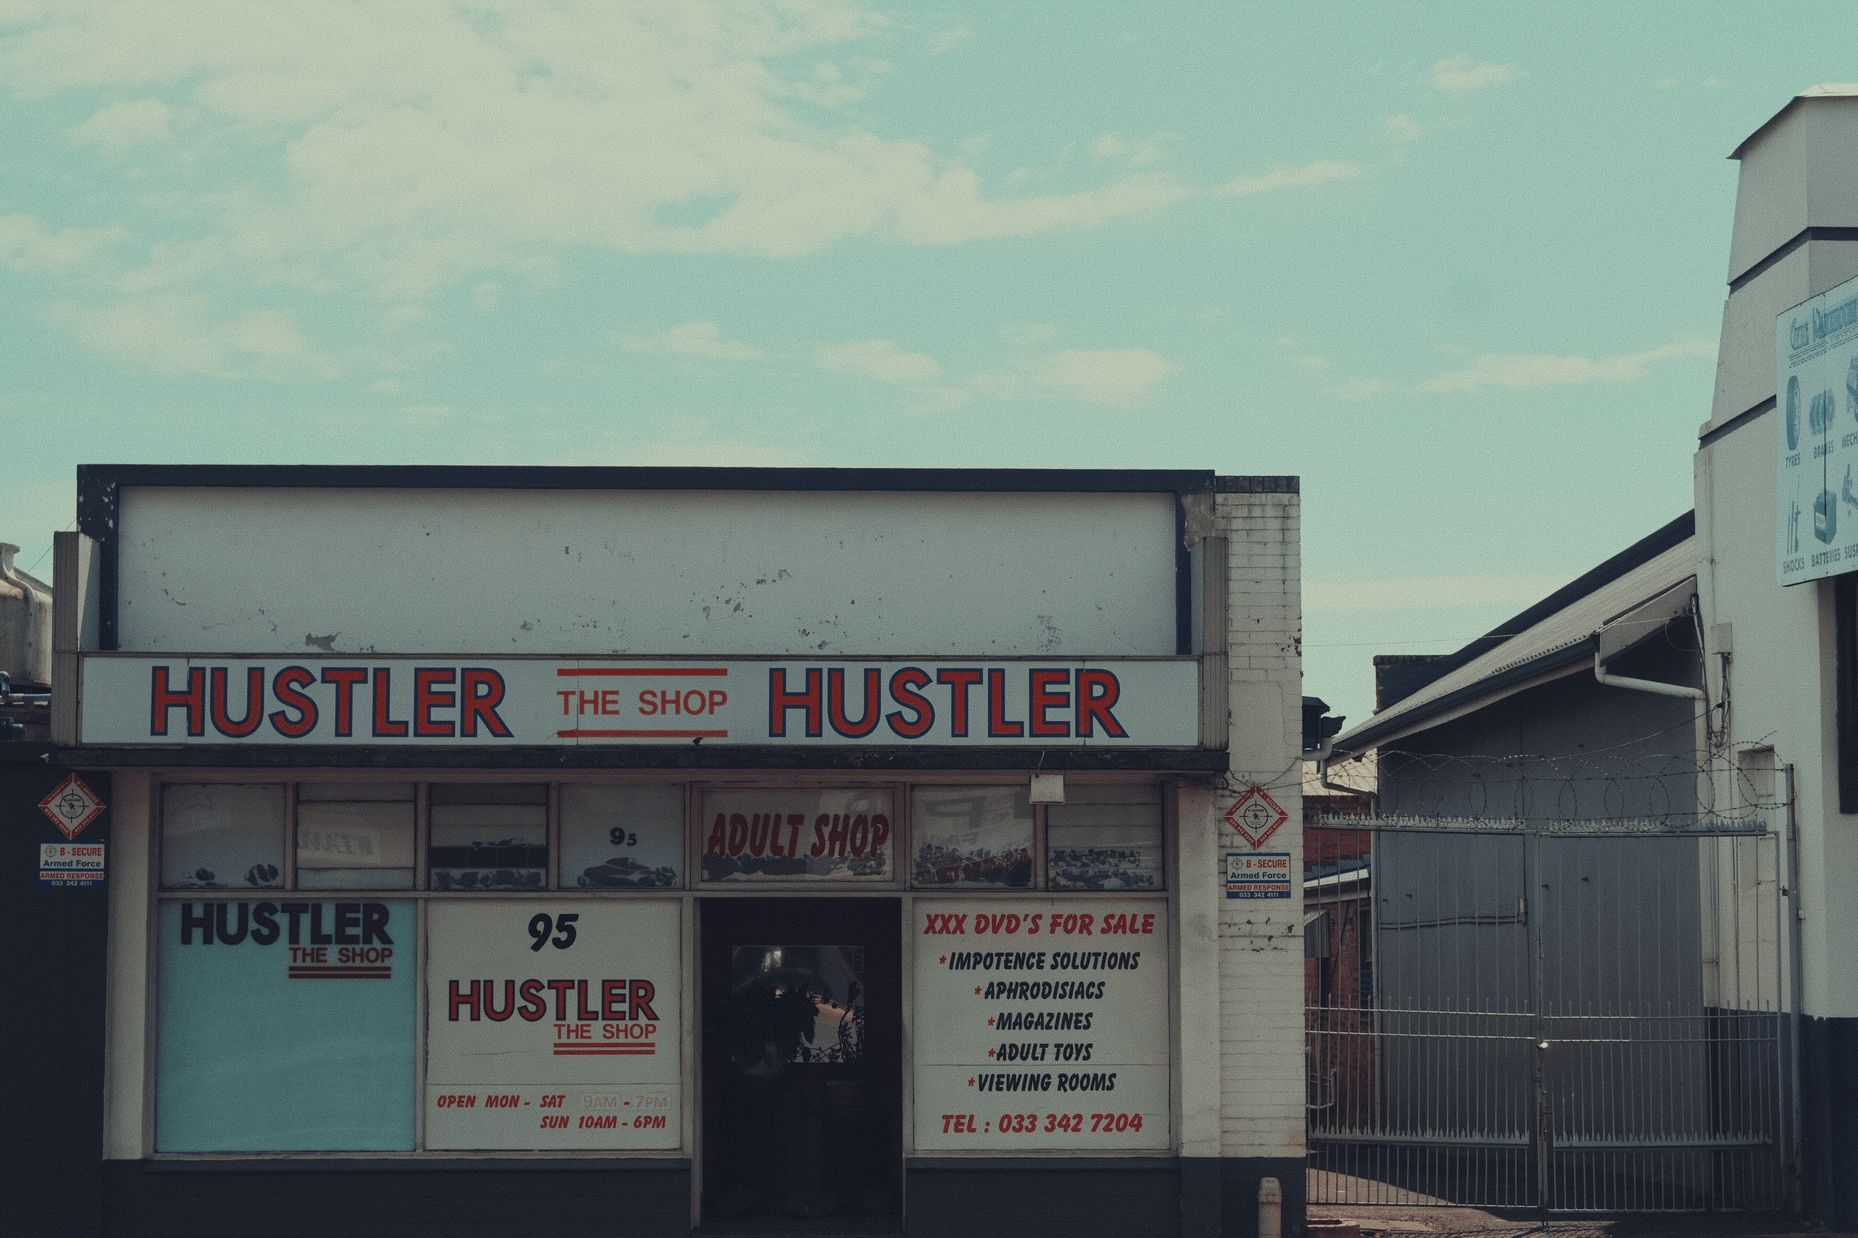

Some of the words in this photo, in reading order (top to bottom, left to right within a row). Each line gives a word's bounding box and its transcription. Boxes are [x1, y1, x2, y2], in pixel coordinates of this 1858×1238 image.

[1785, 452, 1801, 469] TYRES
[1783, 556, 1805, 574] SHOCKS
[1811, 547, 1841, 567] BATTERIES
[150, 665, 515, 739] HUSTLER
[556, 690, 620, 715] THE
[638, 689, 728, 715] SHOP
[768, 666, 1130, 739] HUSTLER
[609, 827, 638, 847] 95
[707, 812, 804, 858] ADULT
[810, 812, 890, 859] SHOP
[60, 847, 66, 856] B
[72, 847, 102, 857] SECURE
[43, 860, 73, 868] Armed
[76, 860, 101, 868] Force
[1246, 860, 1252, 868] B
[1258, 860, 1288, 868] SECURE
[181, 902, 394, 945] HUSTLER
[528, 913, 579, 952] 95
[923, 913, 968, 934] XXX
[974, 913, 1043, 934] DVD'S
[1050, 913, 1095, 936] FOR
[1100, 913, 1156, 934] SALE
[288, 947, 327, 963] THE
[338, 947, 393, 963] SHOP
[949, 952, 1046, 970] IMPOTENCE
[1050, 952, 1140, 970] SOLUTIONS
[448, 978, 660, 1022] HUSTLER
[984, 981, 1105, 1000] APHRODISIACS
[995, 1012, 1093, 1030] MAGAZINES
[553, 1024, 591, 1040] THE
[602, 1024, 657, 1040] SHOP
[996, 1043, 1049, 1062] ADULT
[1054, 1043, 1093, 1062] TOYS
[978, 1073, 1052, 1092] VIEWING
[1057, 1073, 1116, 1092] ROOMS
[437, 1095, 477, 1108] OPEN
[485, 1095, 520, 1108] MON
[540, 1094, 566, 1108] SAT
[584, 1095, 618, 1108] 9AM
[636, 1095, 668, 1108] 7PM
[540, 1116, 570, 1129] SUN
[578, 1116, 618, 1128] 10AM
[634, 1116, 666, 1128] 6PM
[942, 1114, 977, 1134] TEL
[999, 1114, 1038, 1133] 033
[1044, 1114, 1083, 1133] 342
[1090, 1114, 1143, 1133] 7204
